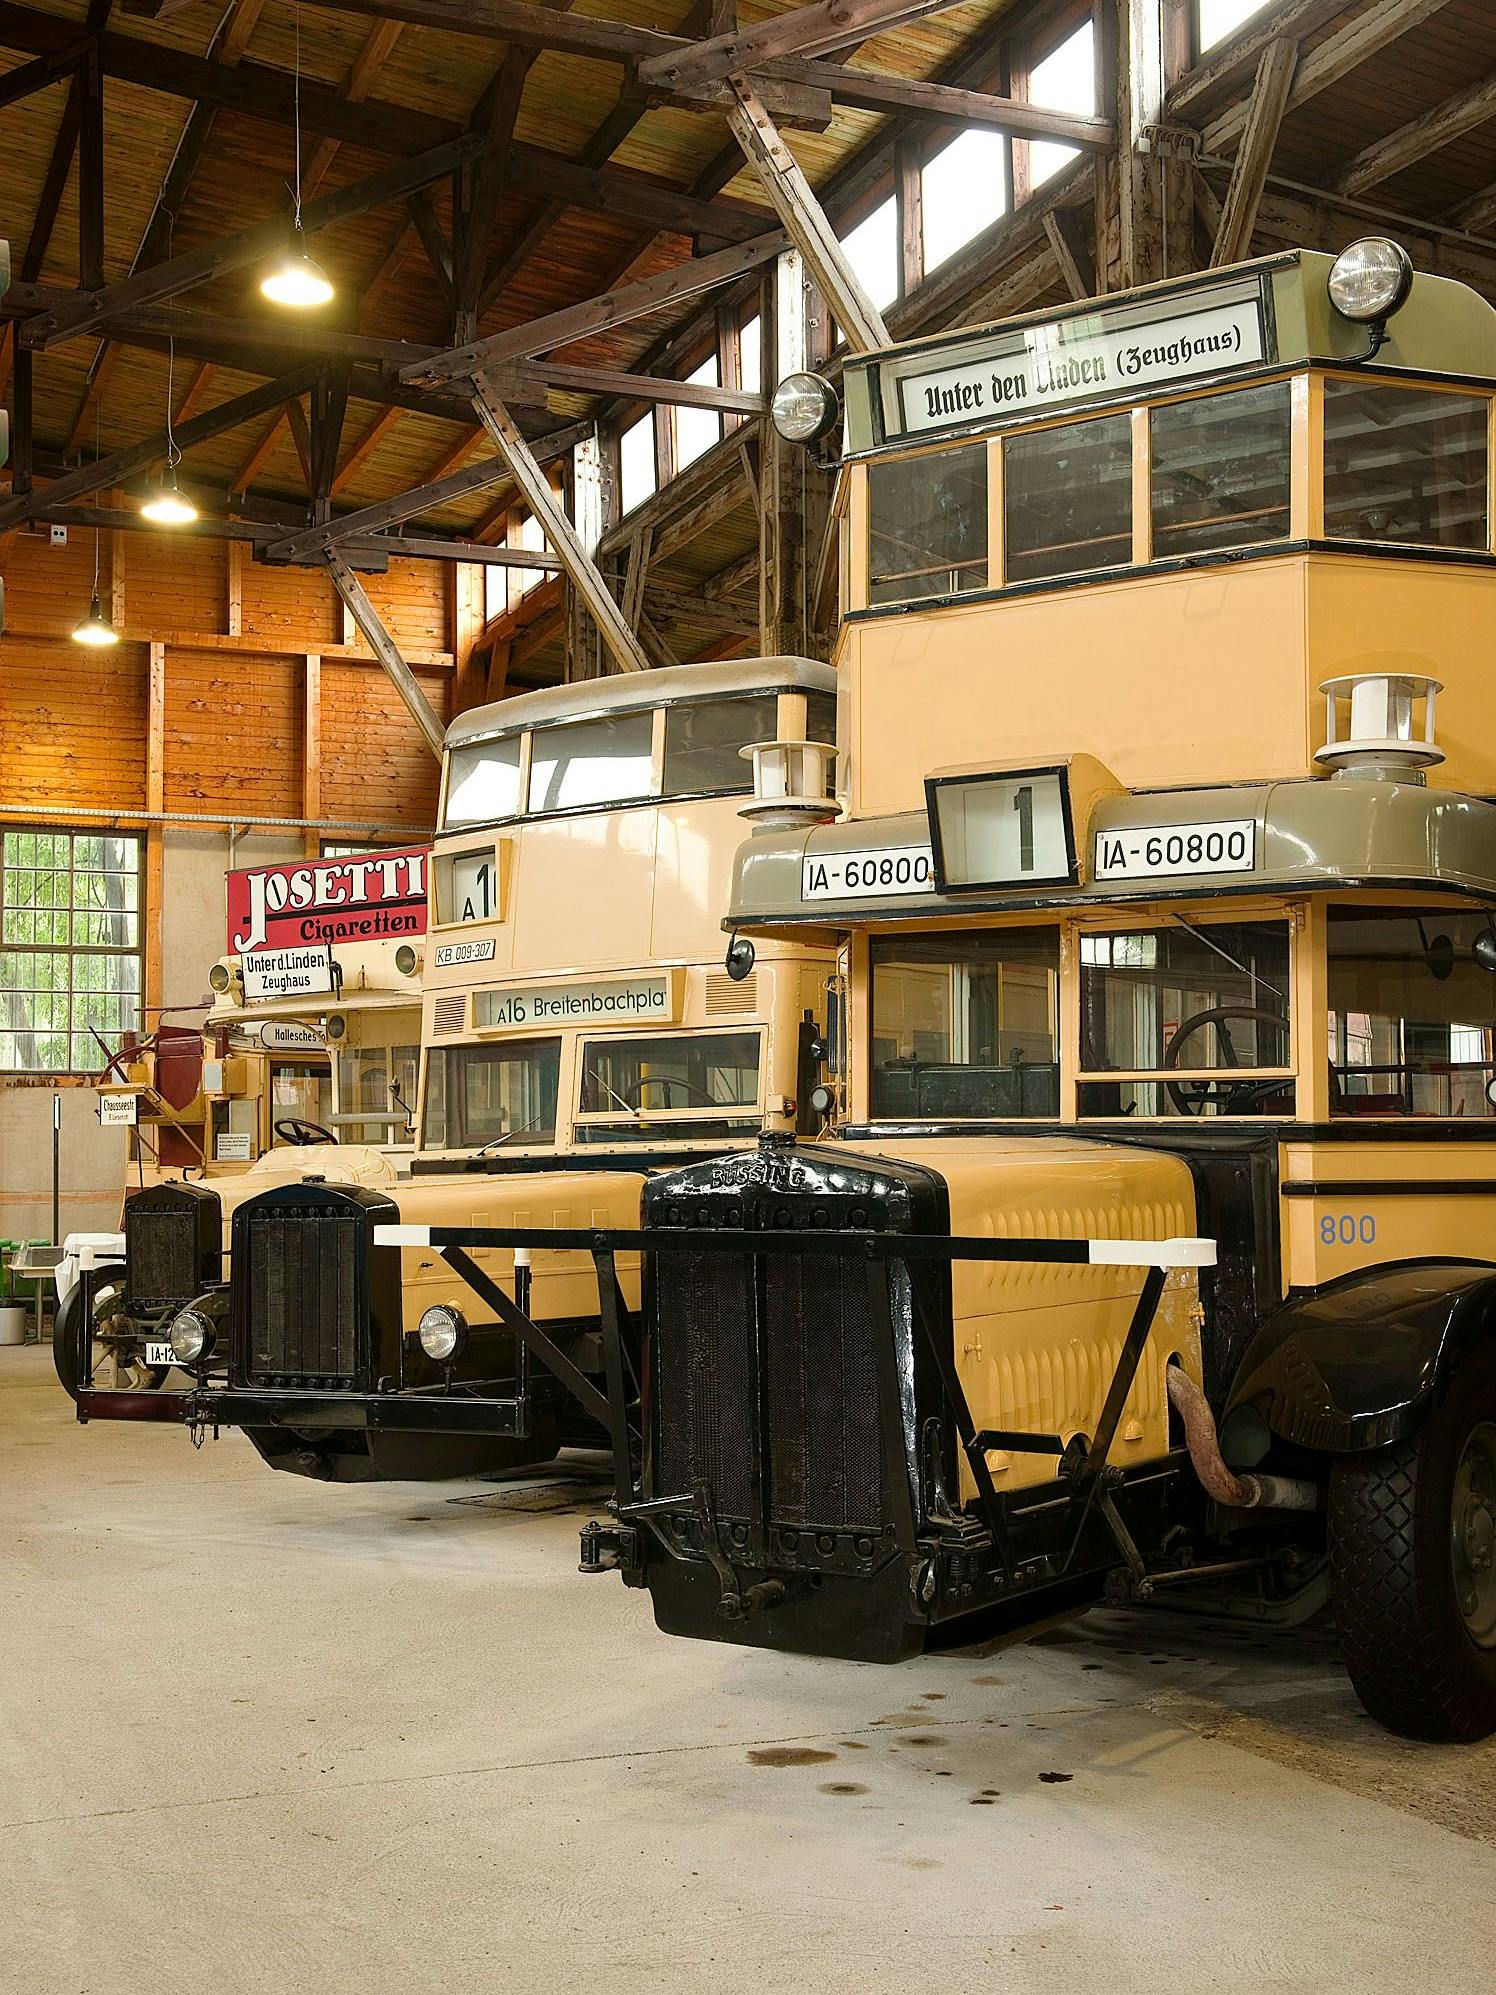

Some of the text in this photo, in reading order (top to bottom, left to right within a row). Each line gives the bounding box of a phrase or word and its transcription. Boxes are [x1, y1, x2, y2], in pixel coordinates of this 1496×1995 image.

[924, 324, 1241, 417] Unter den Linden (Zeughaus)
[1013, 786, 1034, 872] 1
[1103, 831, 1245, 870] IA-60800
[809, 856, 929, 892] IA-60800
[300, 910, 418, 944] Cigaretten
[437, 942, 491, 963] KB 009-307
[262, 973, 311, 993] Zeughaus
[497, 988, 666, 1024] A16 Breitenbachpla
[275, 1028, 317, 1042] Hallesches
[1320, 1215, 1376, 1245] 800
